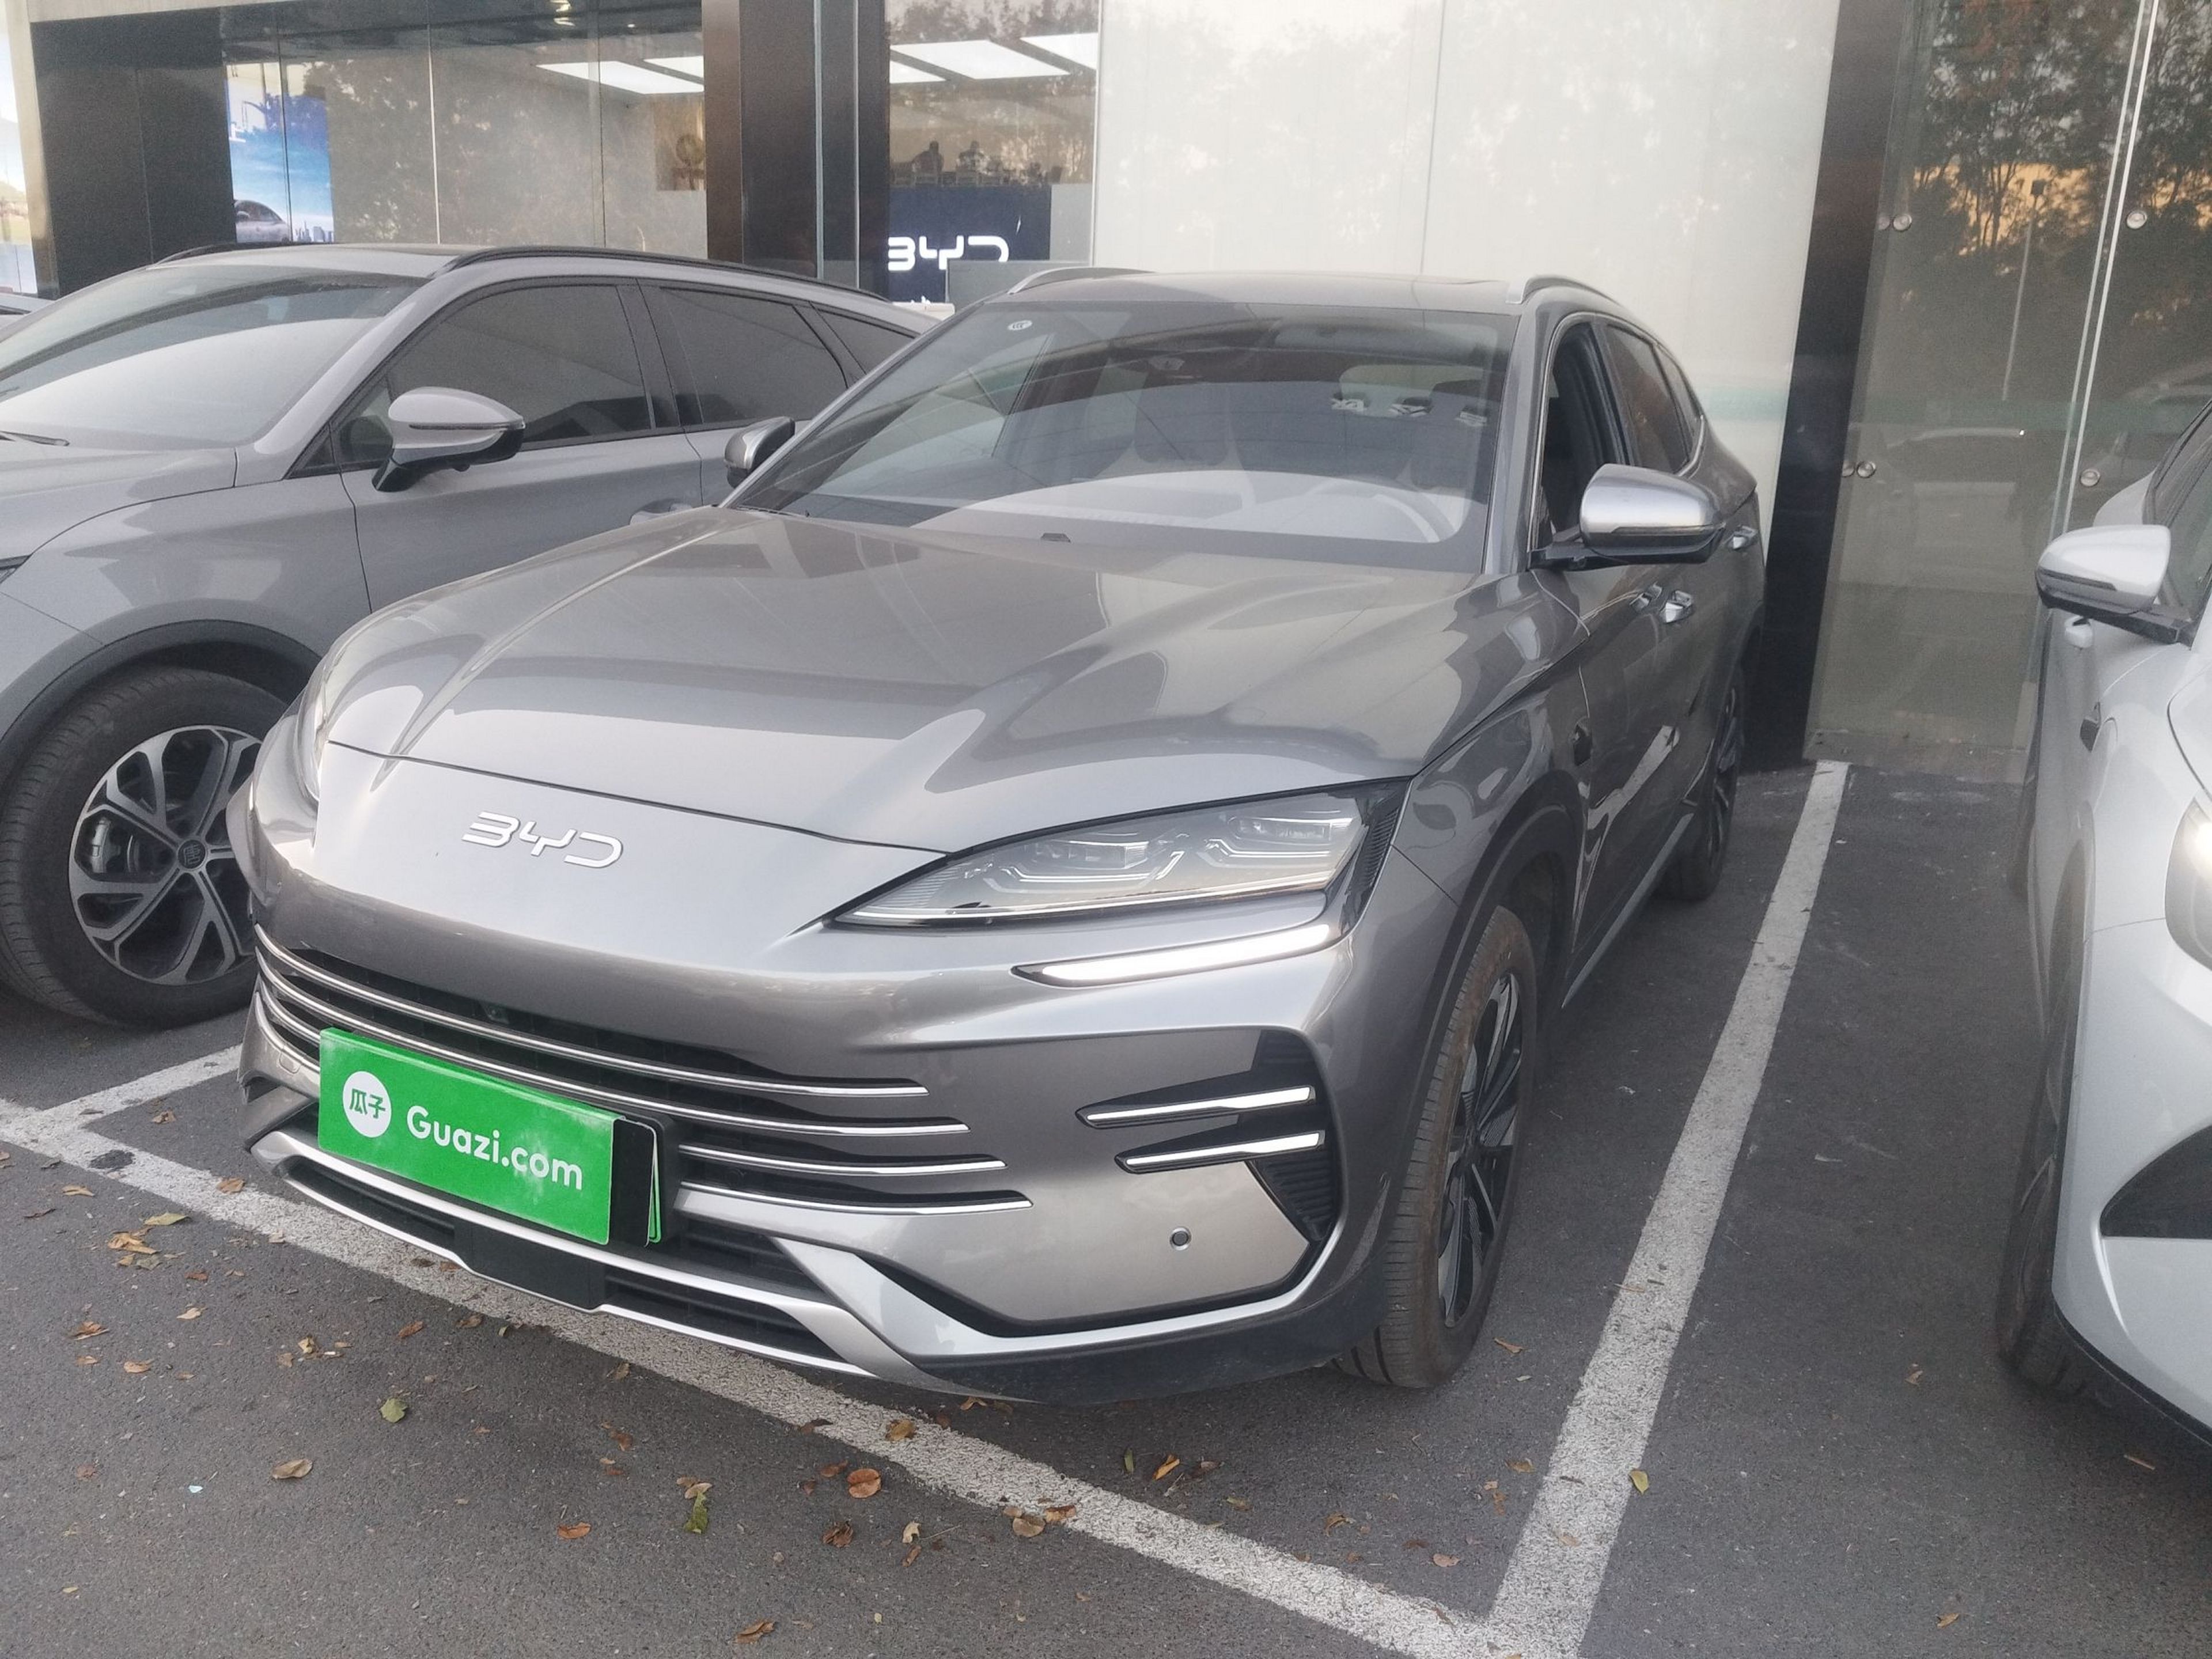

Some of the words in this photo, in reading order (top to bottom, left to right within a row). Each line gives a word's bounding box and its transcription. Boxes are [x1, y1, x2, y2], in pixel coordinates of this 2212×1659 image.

[888, 235, 1009, 271] BYD
[461, 811, 623, 868] BYD
[349, 1089, 385, 1119] 瓜子
[407, 1105, 582, 1190] Guazi.com
